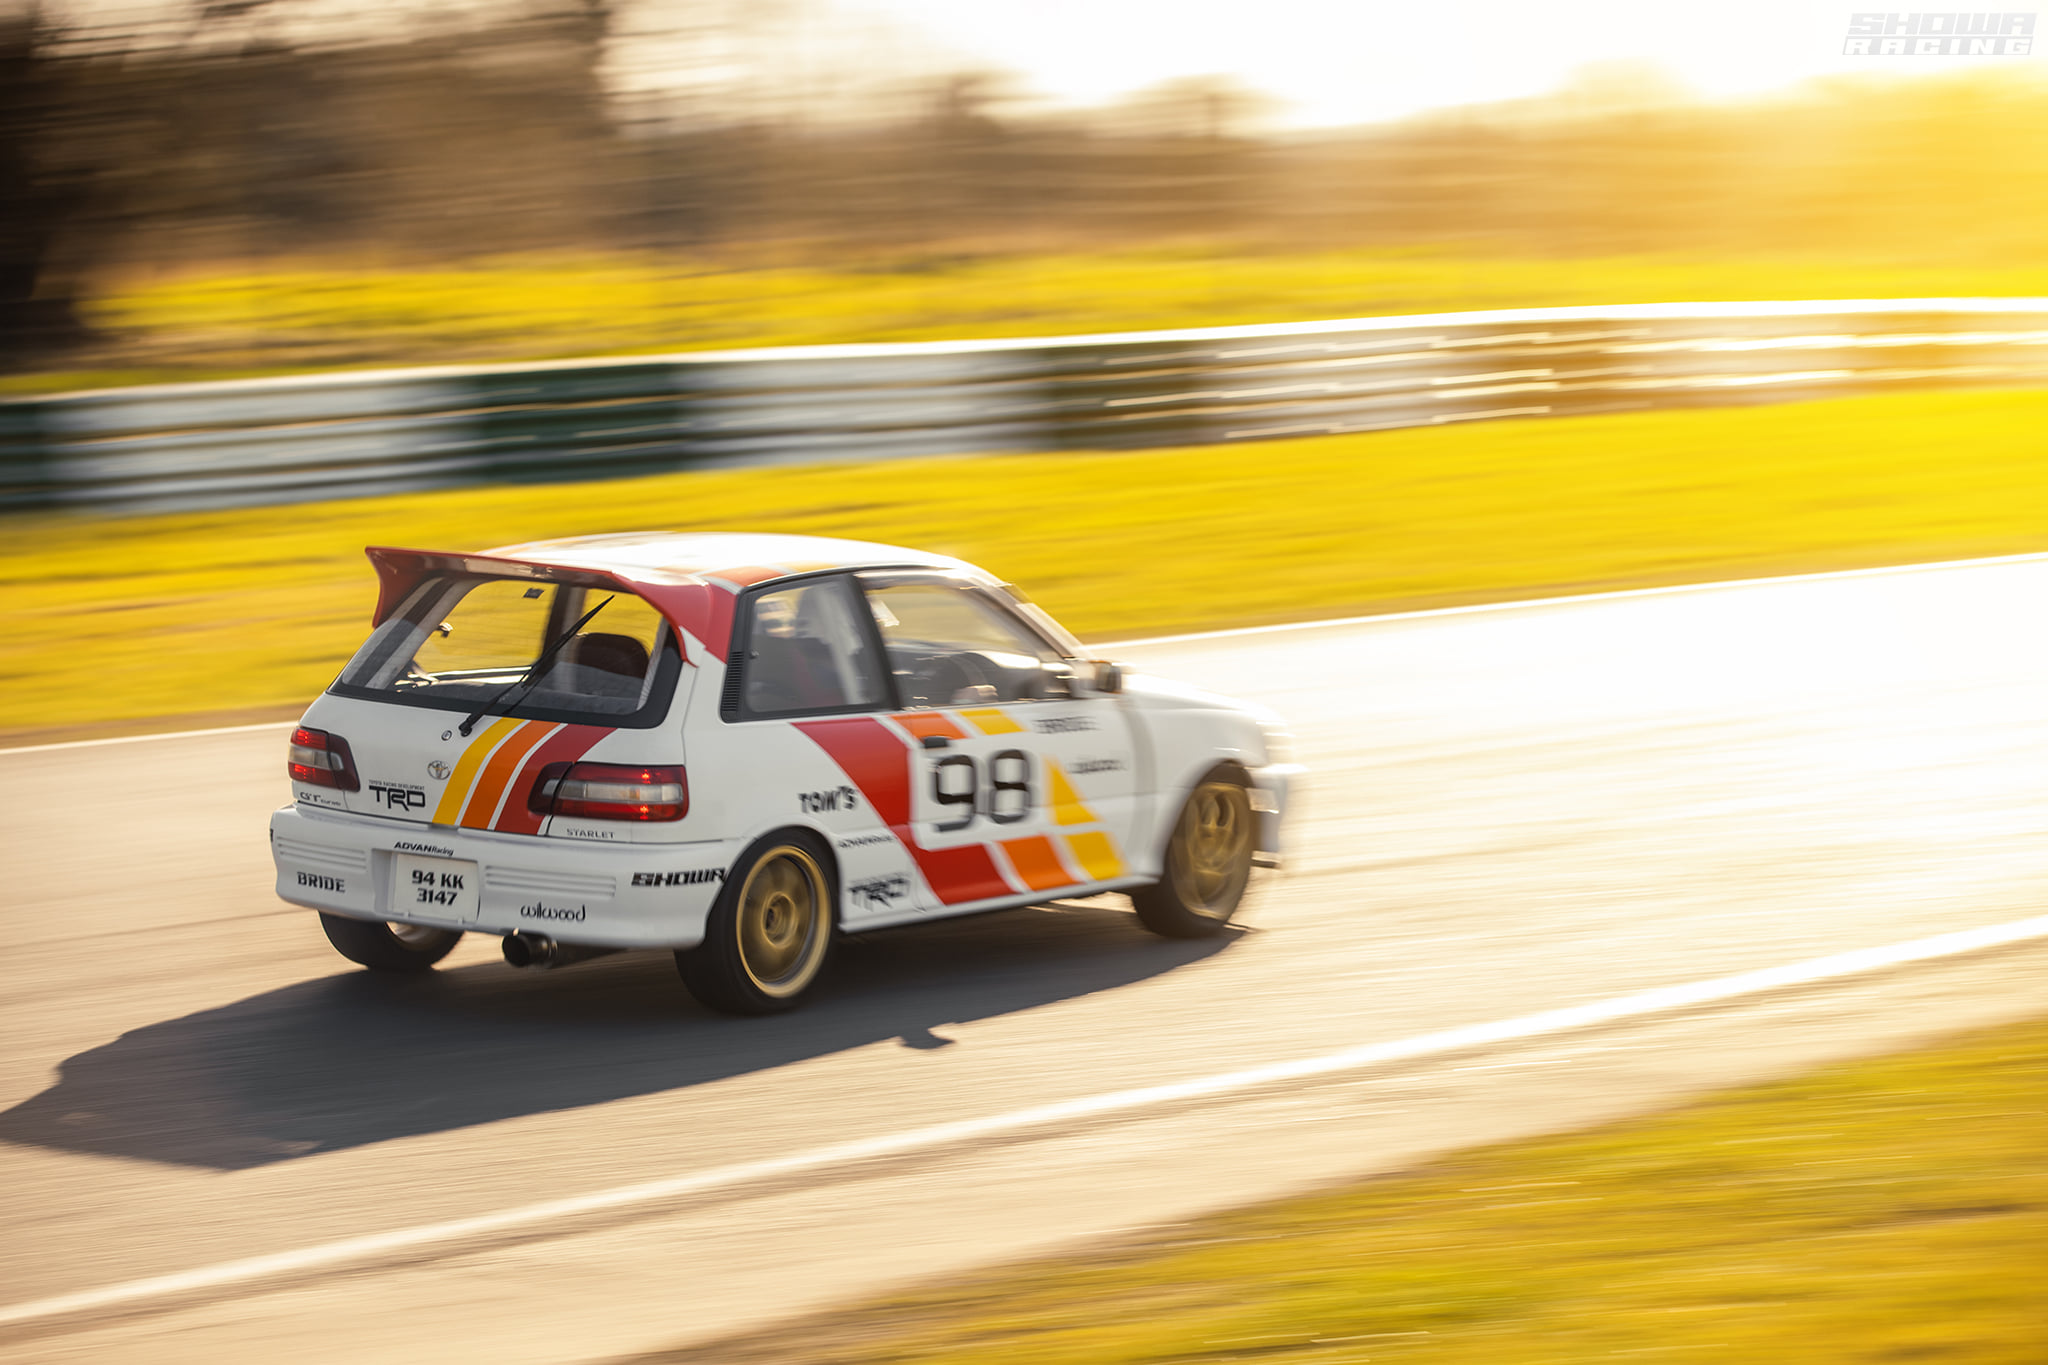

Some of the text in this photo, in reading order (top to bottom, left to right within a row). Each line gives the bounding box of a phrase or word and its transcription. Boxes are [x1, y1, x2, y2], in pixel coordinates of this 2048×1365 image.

[369, 785, 426, 812] TRD
[931, 748, 1032, 832] 98
[566, 828, 616, 840] STARLET
[296, 871, 347, 895] BRIDE
[412, 869, 465, 890] 94 KK
[416, 887, 459, 907] 3147
[520, 902, 587, 923] wilwood
